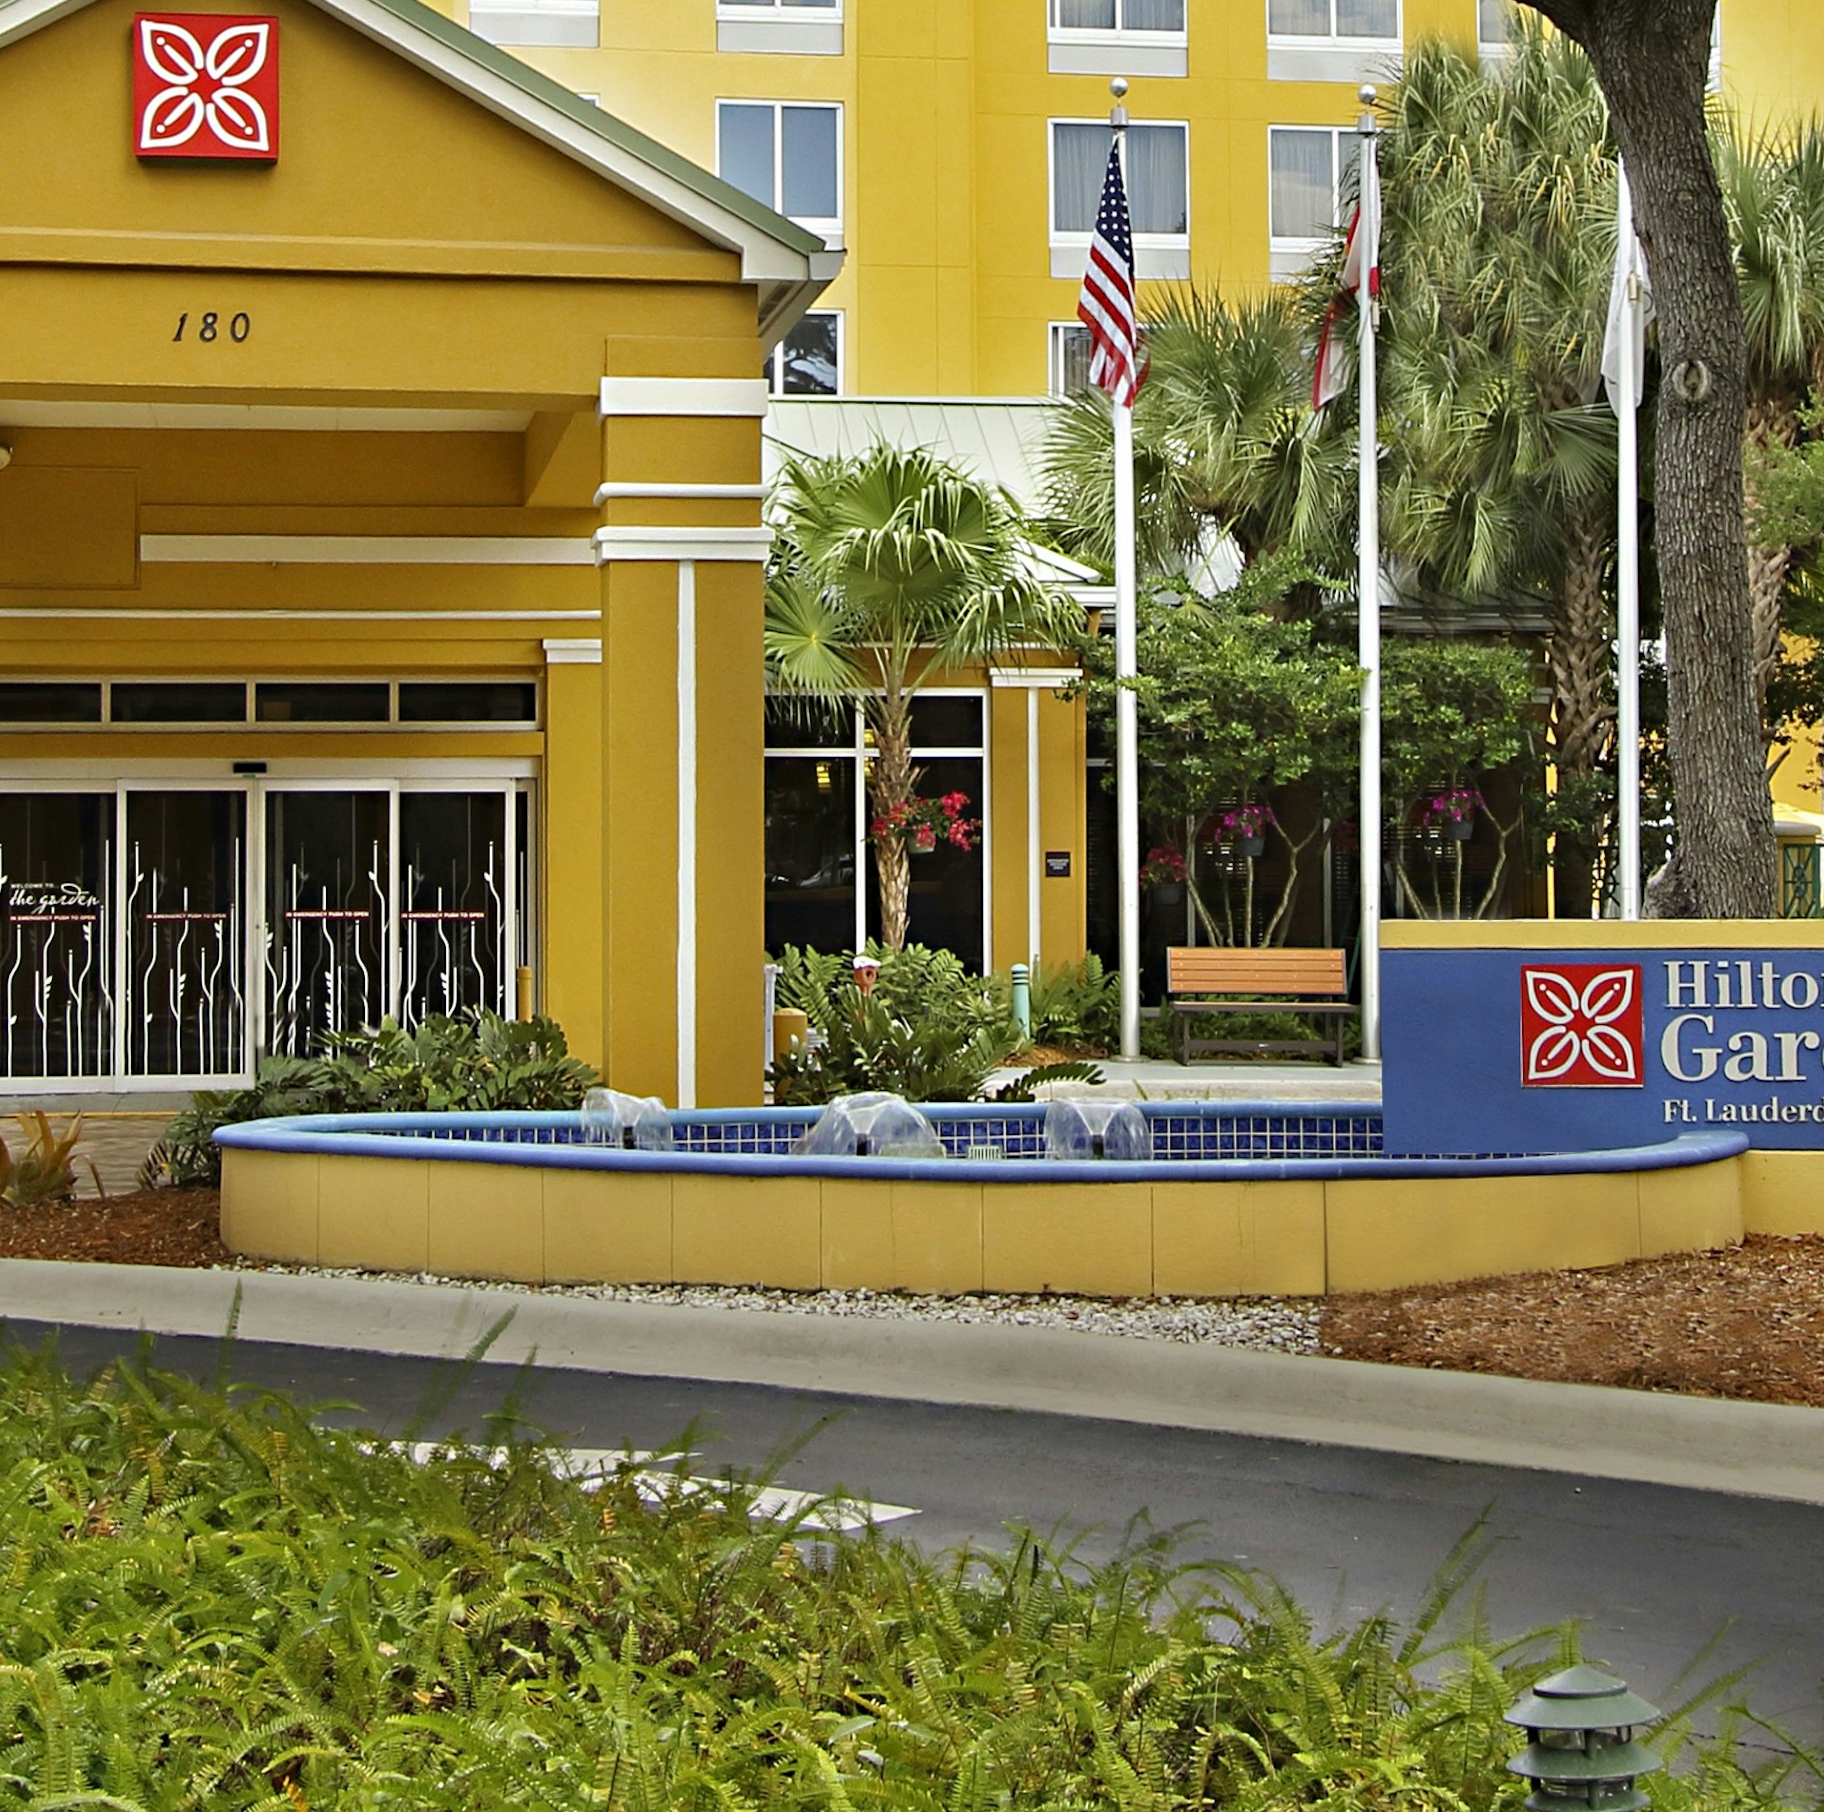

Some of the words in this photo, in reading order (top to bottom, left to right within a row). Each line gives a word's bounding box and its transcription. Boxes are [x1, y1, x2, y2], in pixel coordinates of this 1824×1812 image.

[171, 311, 251, 343] 180
[8, 888, 36, 906] the
[31, 882, 101, 915] garden
[1662, 1098, 1698, 1124] Ft.
